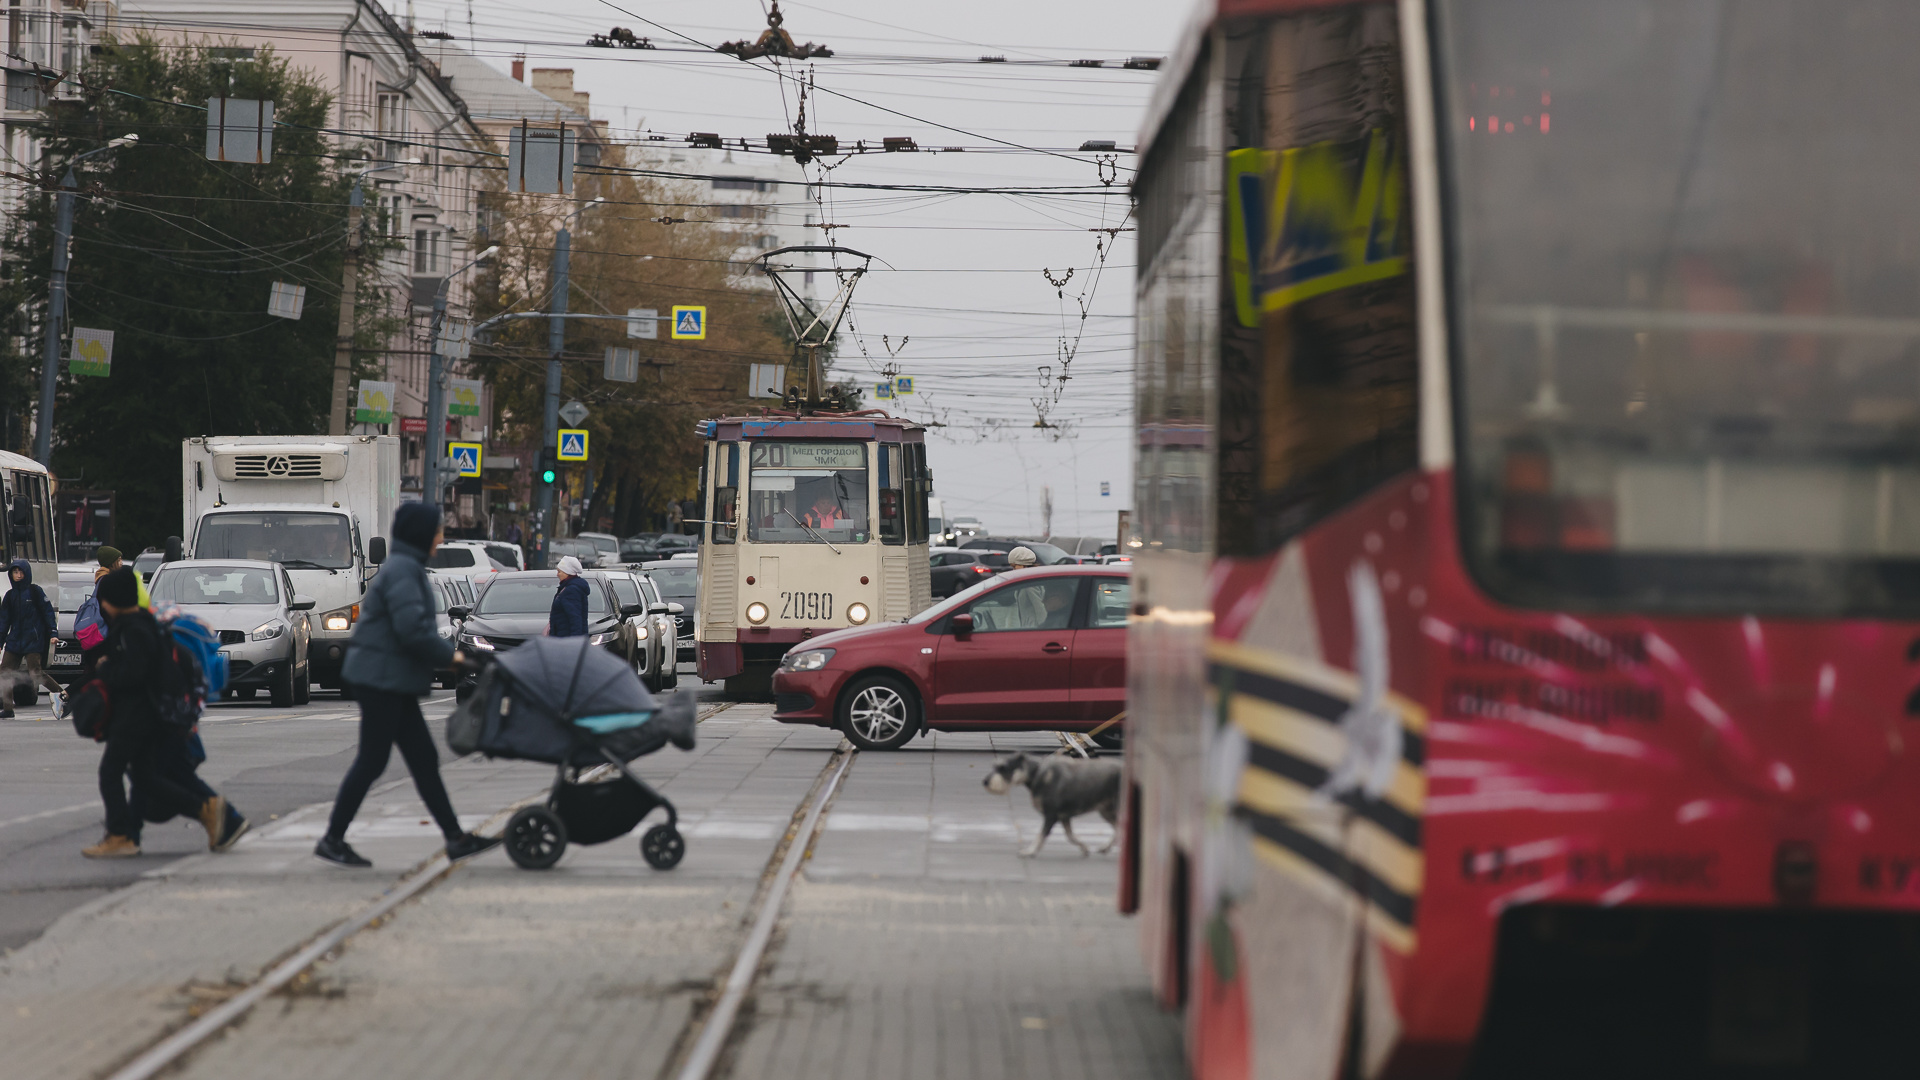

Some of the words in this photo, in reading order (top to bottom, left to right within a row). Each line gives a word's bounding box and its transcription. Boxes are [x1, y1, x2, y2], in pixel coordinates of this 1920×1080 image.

[753, 444, 784, 467] 20
[816, 448, 859, 456] ГОРОДОК
[814, 456, 837, 465] ЧМК
[780, 591, 832, 620] 2090
